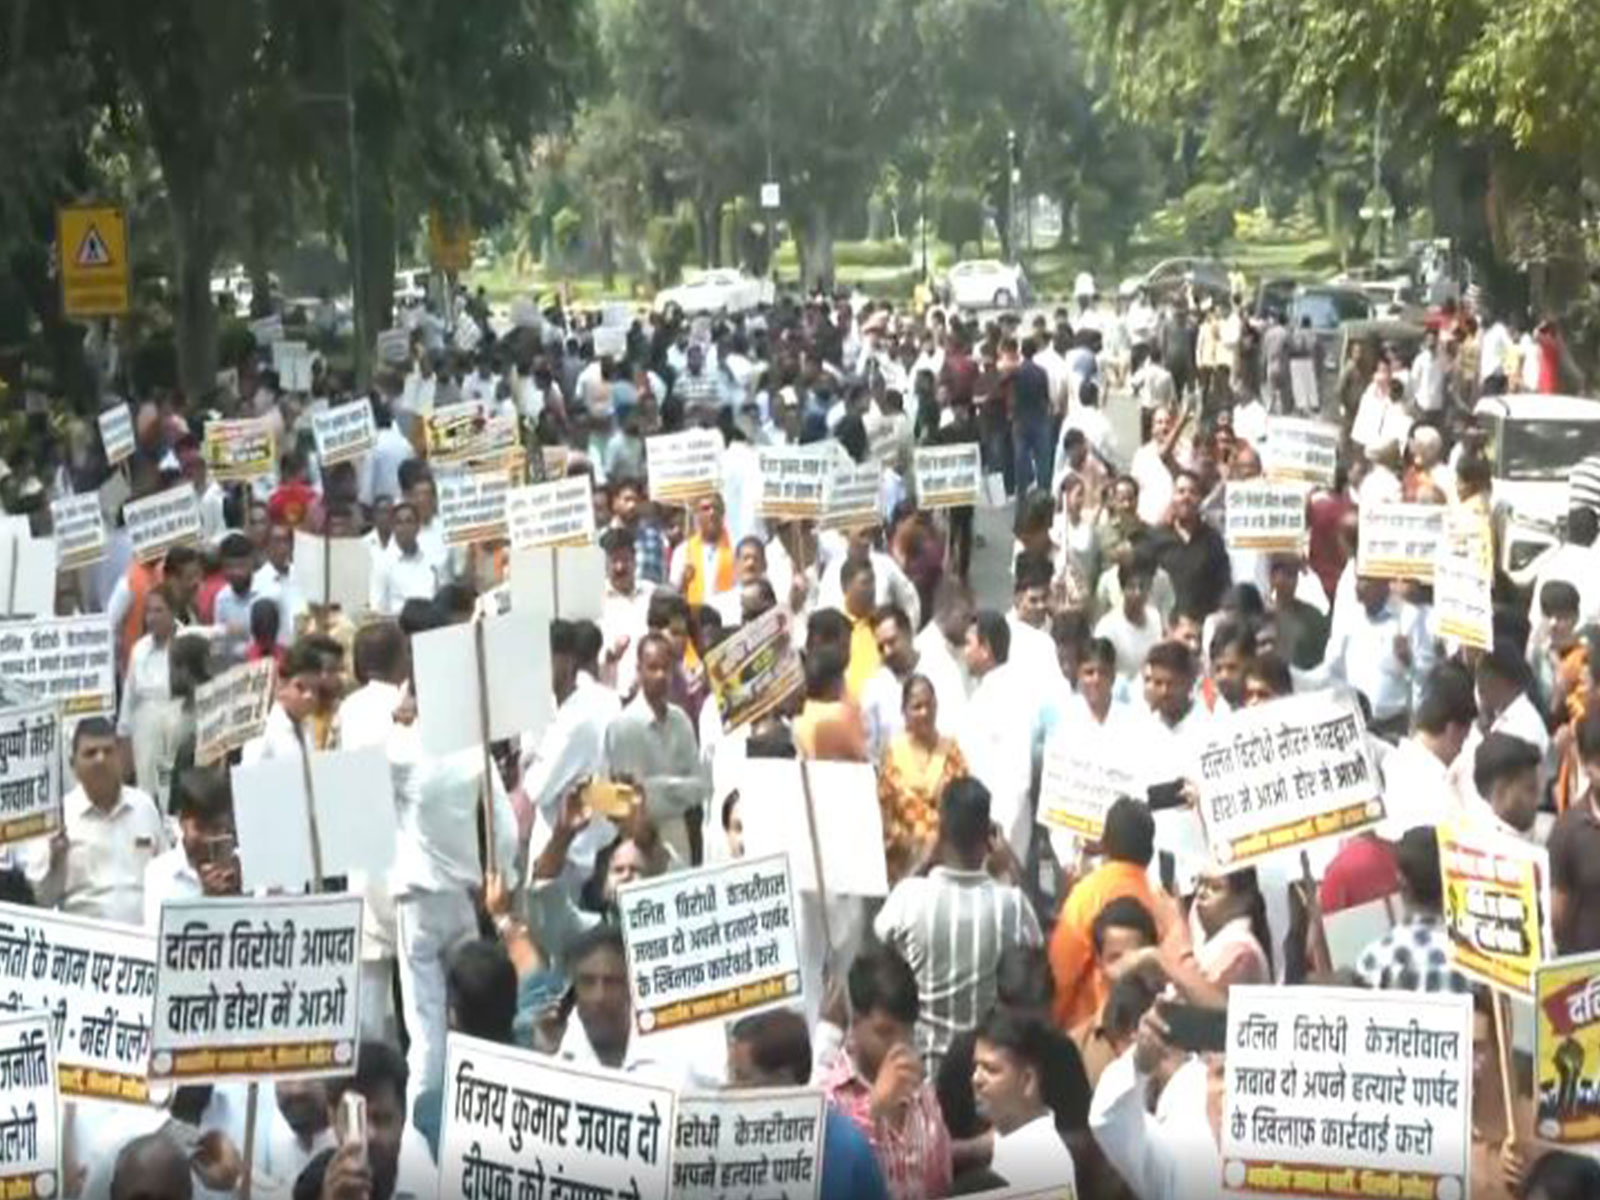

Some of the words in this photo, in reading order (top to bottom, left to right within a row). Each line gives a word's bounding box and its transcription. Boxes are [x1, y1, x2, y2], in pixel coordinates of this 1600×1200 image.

[32, 928, 51, 980] के
[92, 951, 115, 994] पर
[165, 921, 225, 972] दलित
[229, 919, 297, 970] विरोधी
[300, 926, 356, 967] आपदा
[168, 981, 221, 1034] वालो
[223, 980, 268, 1030] होश
[271, 979, 297, 1028] में
[296, 976, 348, 1029] आओ
[80, 1005, 117, 1059] नहीं
[1236, 1013, 1279, 1050] दलित
[1293, 1014, 1349, 1056] विरोधी
[1364, 1017, 1460, 1061] केजरीवाल
[1234, 1066, 1276, 1097] जवाब
[1280, 1060, 1298, 1098] दो
[1303, 1062, 1347, 1102] अपने
[1351, 1067, 1407, 1107] हत्यारे
[1412, 1069, 1460, 1109] पार्षद
[454, 1059, 508, 1133] विजय
[508, 1087, 572, 1153] कुमार
[574, 1102, 634, 1160] जवाब
[636, 1100, 662, 1166] दो
[734, 1110, 816, 1146] केजरीवाल
[1230, 1105, 1247, 1142] के
[1394, 1117, 1435, 1156] करो
[672, 1154, 717, 1188] अपने
[719, 1153, 770, 1188] हत्यारे
[771, 1149, 814, 1183] पार्षद
